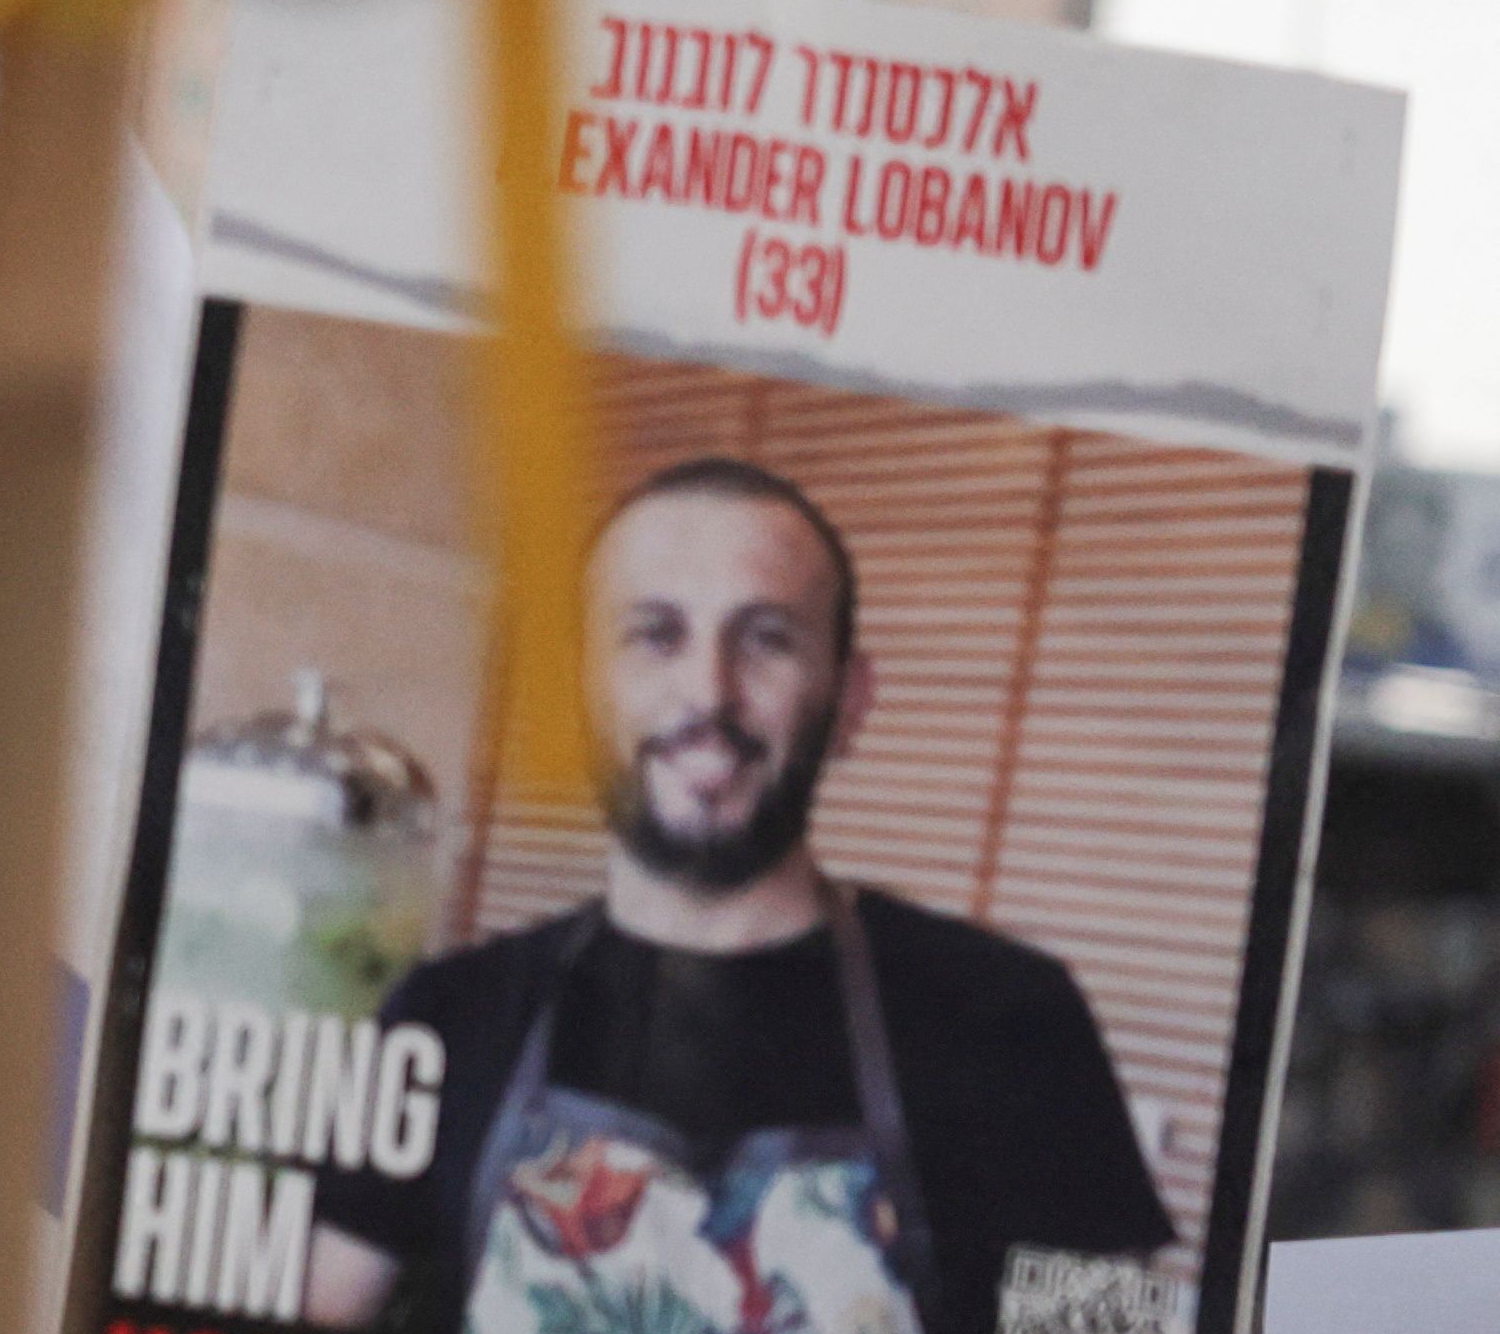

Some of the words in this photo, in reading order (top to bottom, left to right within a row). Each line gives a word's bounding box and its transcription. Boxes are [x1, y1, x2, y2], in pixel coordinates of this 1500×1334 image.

[588, 15, 776, 115] לובנוב
[793, 45, 1040, 161] אלכסנדר
[557, 107, 828, 227] EXANDER
[840, 153, 1118, 273] LOBANOV
[732, 227, 848, 339] (33)
[132, 997, 448, 1181] BRING
[112, 1147, 317, 1325] HIM
